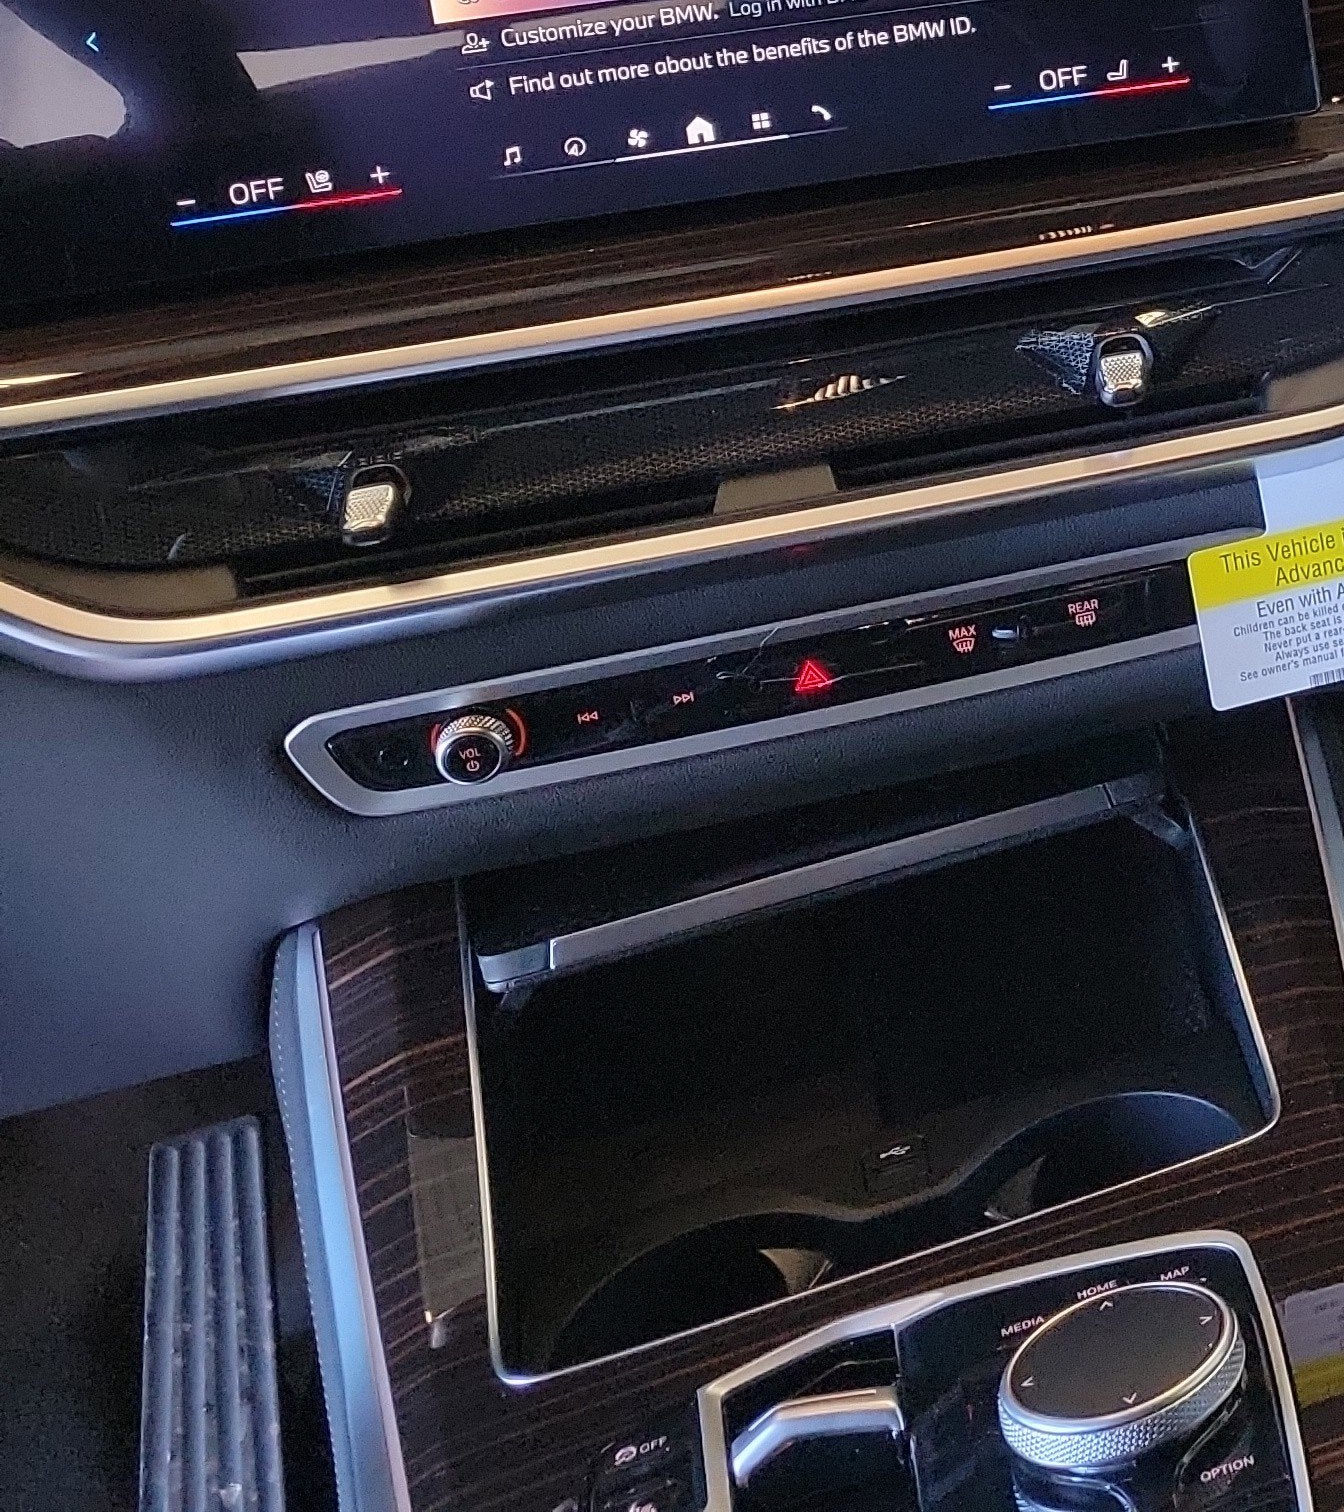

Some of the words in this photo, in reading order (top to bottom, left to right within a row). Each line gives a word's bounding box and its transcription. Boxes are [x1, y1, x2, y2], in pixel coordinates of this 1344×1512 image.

[500, 18, 607, 47] Customize
[610, 11, 656, 35] your
[659, 2, 719, 26] BMW.
[728, 0, 762, 19] Log
[508, 72, 555, 95] Find
[559, 68, 594, 87] out
[598, 62, 650, 82] more
[654, 52, 713, 75] about
[717, 48, 748, 67] the
[752, 38, 831, 62] benefits
[834, 33, 855, 51] of
[857, 28, 889, 48] the
[892, 19, 945, 43] BMW
[949, 16, 977, 35] ID.
[1039, 65, 1087, 90] OFF
[229, 177, 284, 205] OFF
[1220, 550, 1261, 573] This
[1266, 533, 1335, 562] Vehicle
[1067, 599, 1099, 615] REAR
[1257, 598, 1294, 618] Even
[1298, 587, 1331, 608] with
[949, 624, 977, 640] MAX
[1234, 620, 1274, 637] Children
[1278, 615, 1295, 626] can
[1298, 610, 1309, 621] be
[1313, 604, 1338, 617] killed
[1263, 629, 1284, 641] The
[1285, 623, 1307, 636] back
[1311, 617, 1330, 629] seat
[1334, 615, 1342, 625] is
[1264, 639, 1292, 652] Never
[1296, 633, 1312, 646] put
[1275, 646, 1309, 661] Always
[1313, 642, 1329, 653] use
[1240, 670, 1258, 682] See
[1262, 659, 1299, 677] owner's
[1303, 650, 1338, 666] manual
[459, 748, 481, 760] VOL
[1160, 1266, 1190, 1281] MAP
[1077, 1280, 1119, 1300] HOME
[1001, 1316, 1045, 1337] MEDIA
[1200, 1455, 1255, 1482] OPTION
